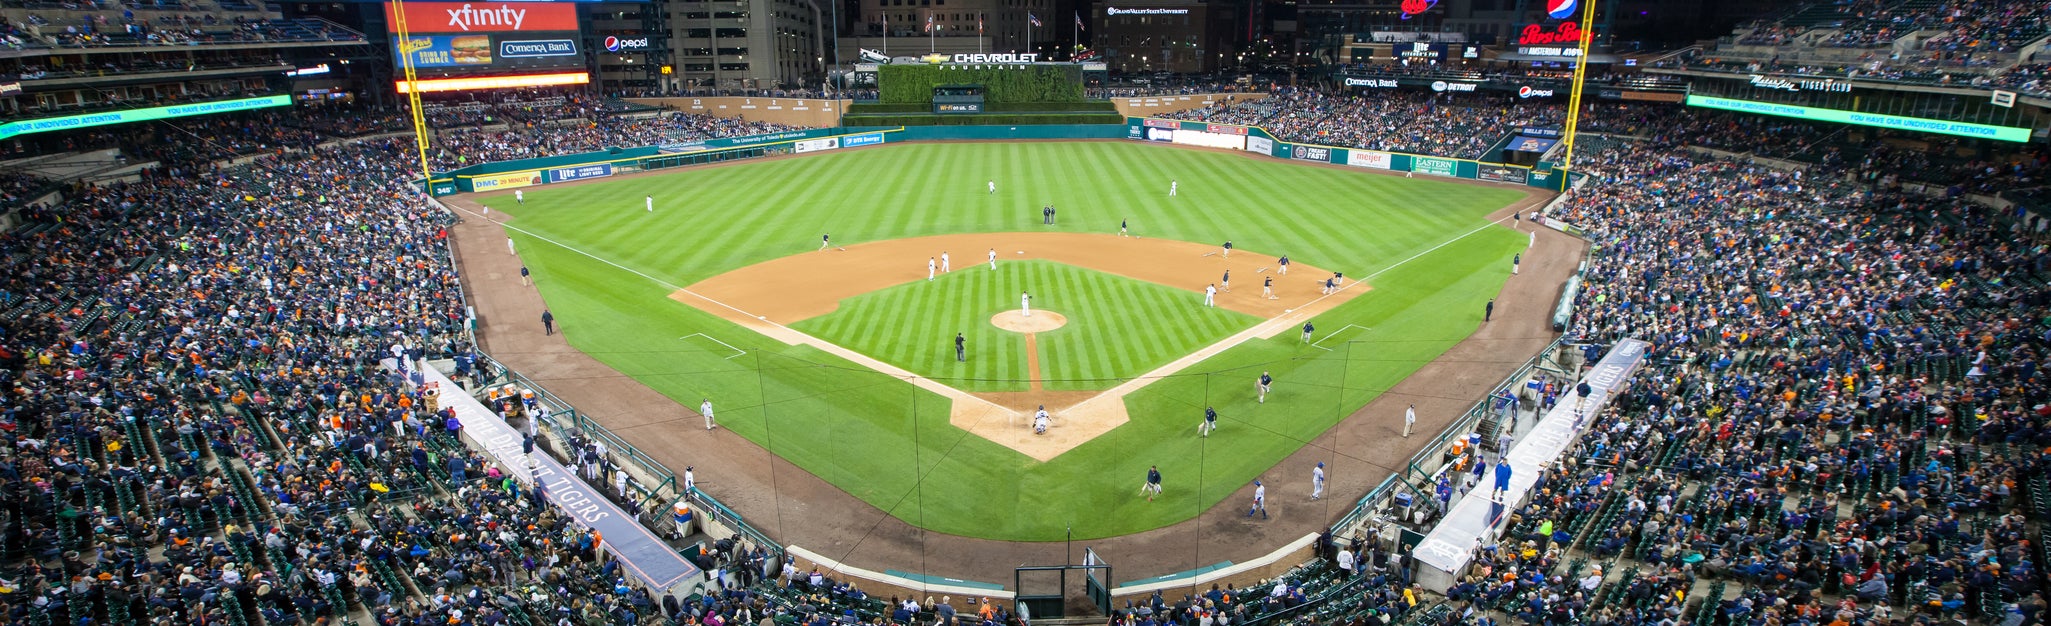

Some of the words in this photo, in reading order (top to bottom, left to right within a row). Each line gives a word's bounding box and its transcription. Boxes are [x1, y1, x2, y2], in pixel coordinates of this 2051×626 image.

[447, 4, 526, 31] xfinity
[549, 42, 570, 51] Bank
[620, 37, 648, 49] pepsi
[1413, 42, 1430, 52] Lite
[1528, 47, 1562, 56] AMSTERDAM
[954, 53, 1038, 63] CHEVROLET
[1378, 79, 1398, 87] Bank
[1447, 83, 1477, 91] DETROIT
[1531, 89, 1553, 97] pepsi
[35, 118, 80, 130] UNDIVIDED
[82, 113, 122, 125] ATTENTION
[1865, 116, 1885, 124] HAVE
[1887, 118, 1901, 126] OUR
[1903, 120, 1948, 131] UNDIVIDED
[1949, 125, 1997, 136] ATTENTION
[1356, 151, 1382, 163] meijer
[1416, 157, 1452, 169] EASTERN
[559, 169, 576, 180] Lite
[475, 179, 498, 188] DMC
[508, 176, 530, 184] MINUTE
[546, 477, 609, 523] TIGERS
